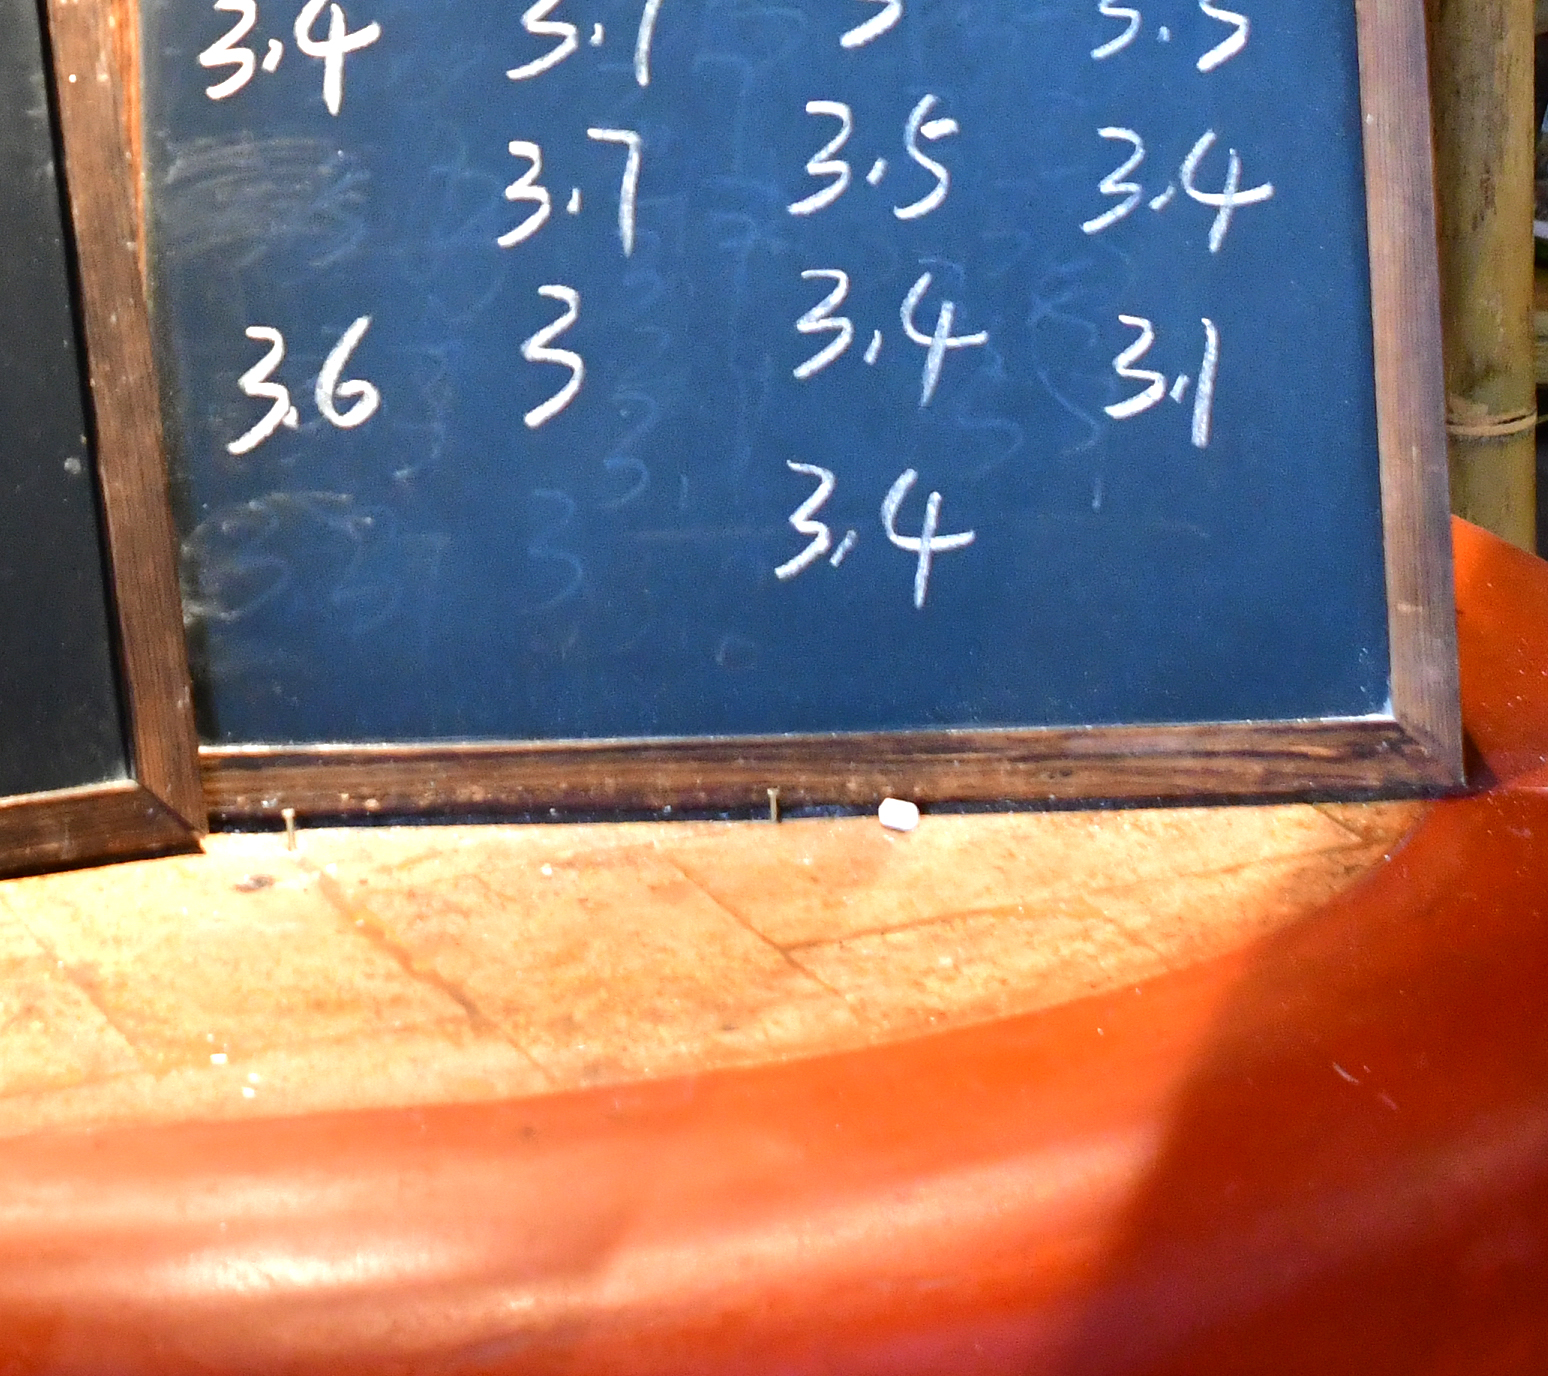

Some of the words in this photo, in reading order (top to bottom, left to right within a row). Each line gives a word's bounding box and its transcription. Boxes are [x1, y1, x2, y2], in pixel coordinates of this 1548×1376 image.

[497, 128, 640, 252] 3.7
[788, 94, 958, 220] 3.5
[1082, 126, 1274, 252] 3.4
[227, 317, 379, 454] 3.6
[522, 285, 583, 428] 3
[794, 269, 988, 401] 3.4
[1105, 314, 1218, 446] 3.1
[775, 461, 974, 606] 3.4
